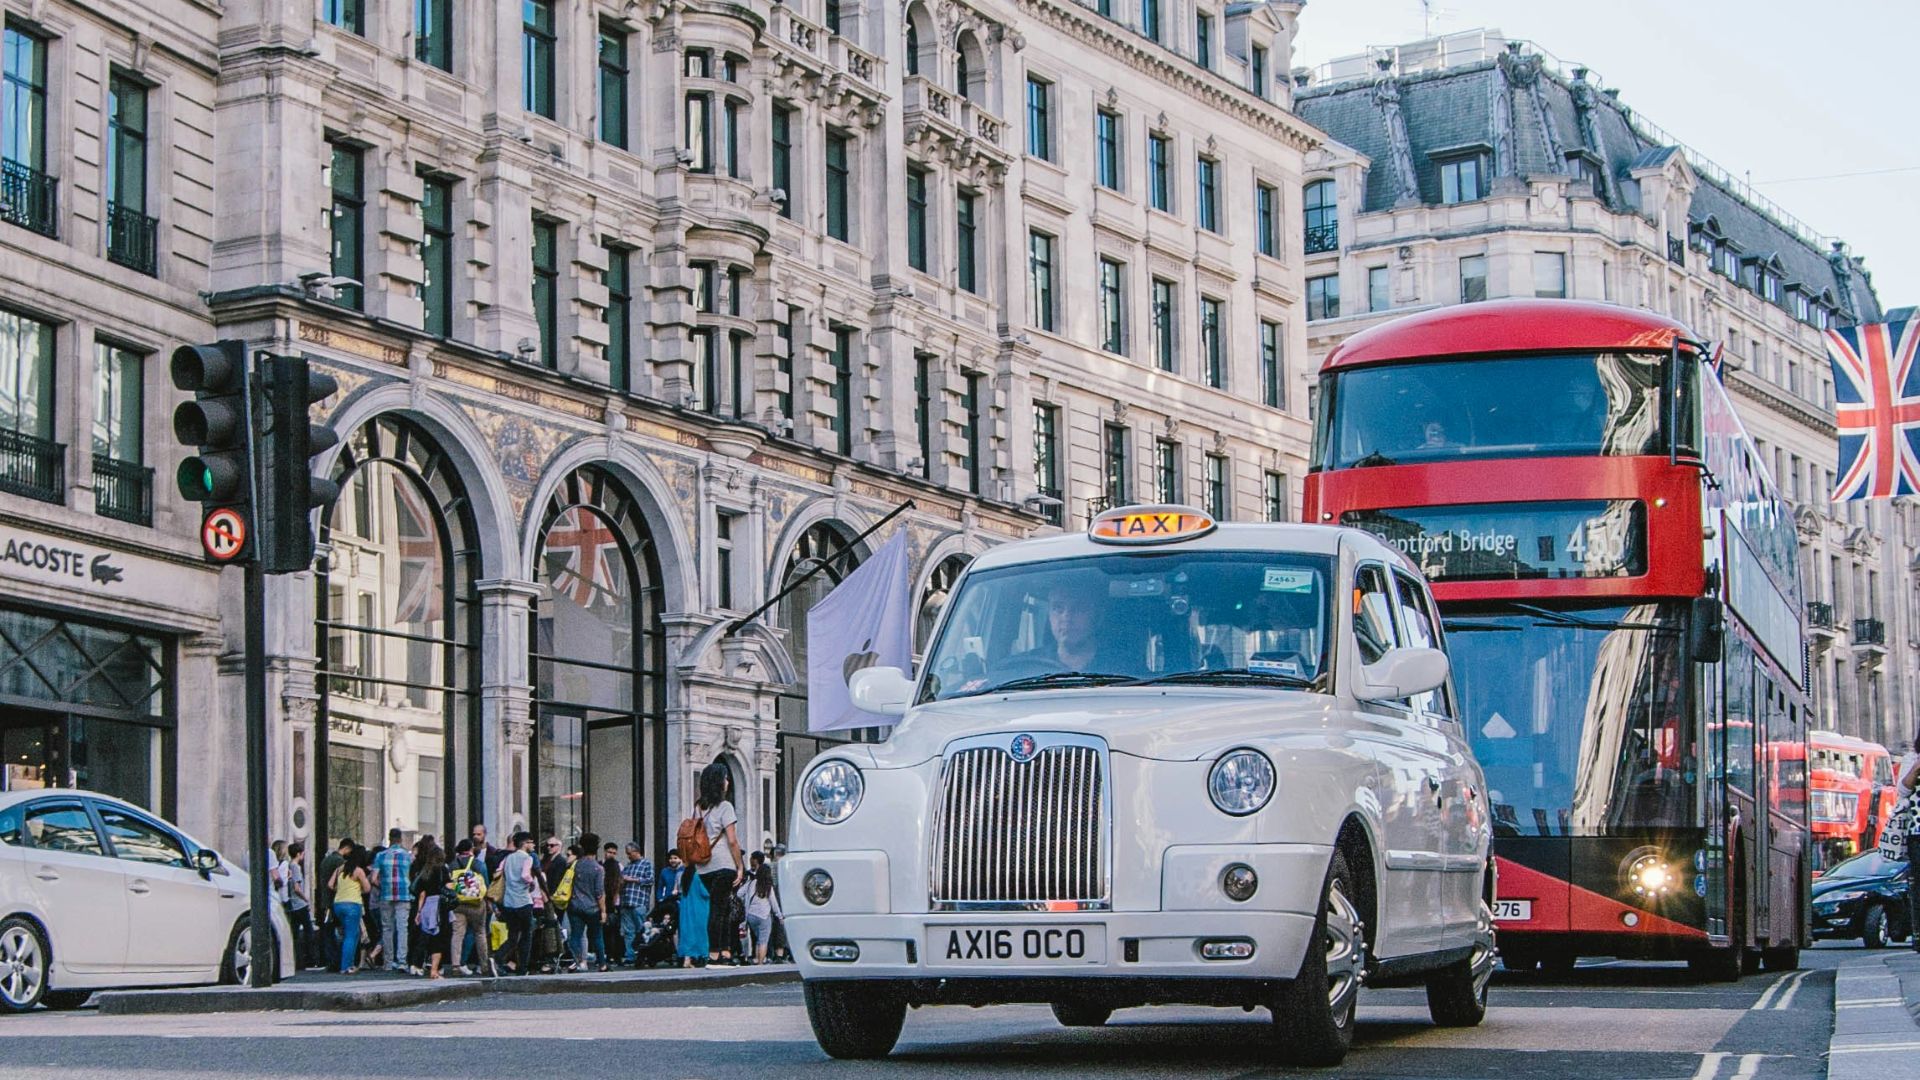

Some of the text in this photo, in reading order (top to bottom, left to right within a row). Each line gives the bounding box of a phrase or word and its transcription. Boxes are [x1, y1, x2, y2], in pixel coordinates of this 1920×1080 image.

[1112, 515, 1183, 537] TAXI
[1460, 528, 1515, 556] Bridge
[0, 539, 84, 577] ACOSTE
[946, 929, 1085, 959] AX16 OCO
